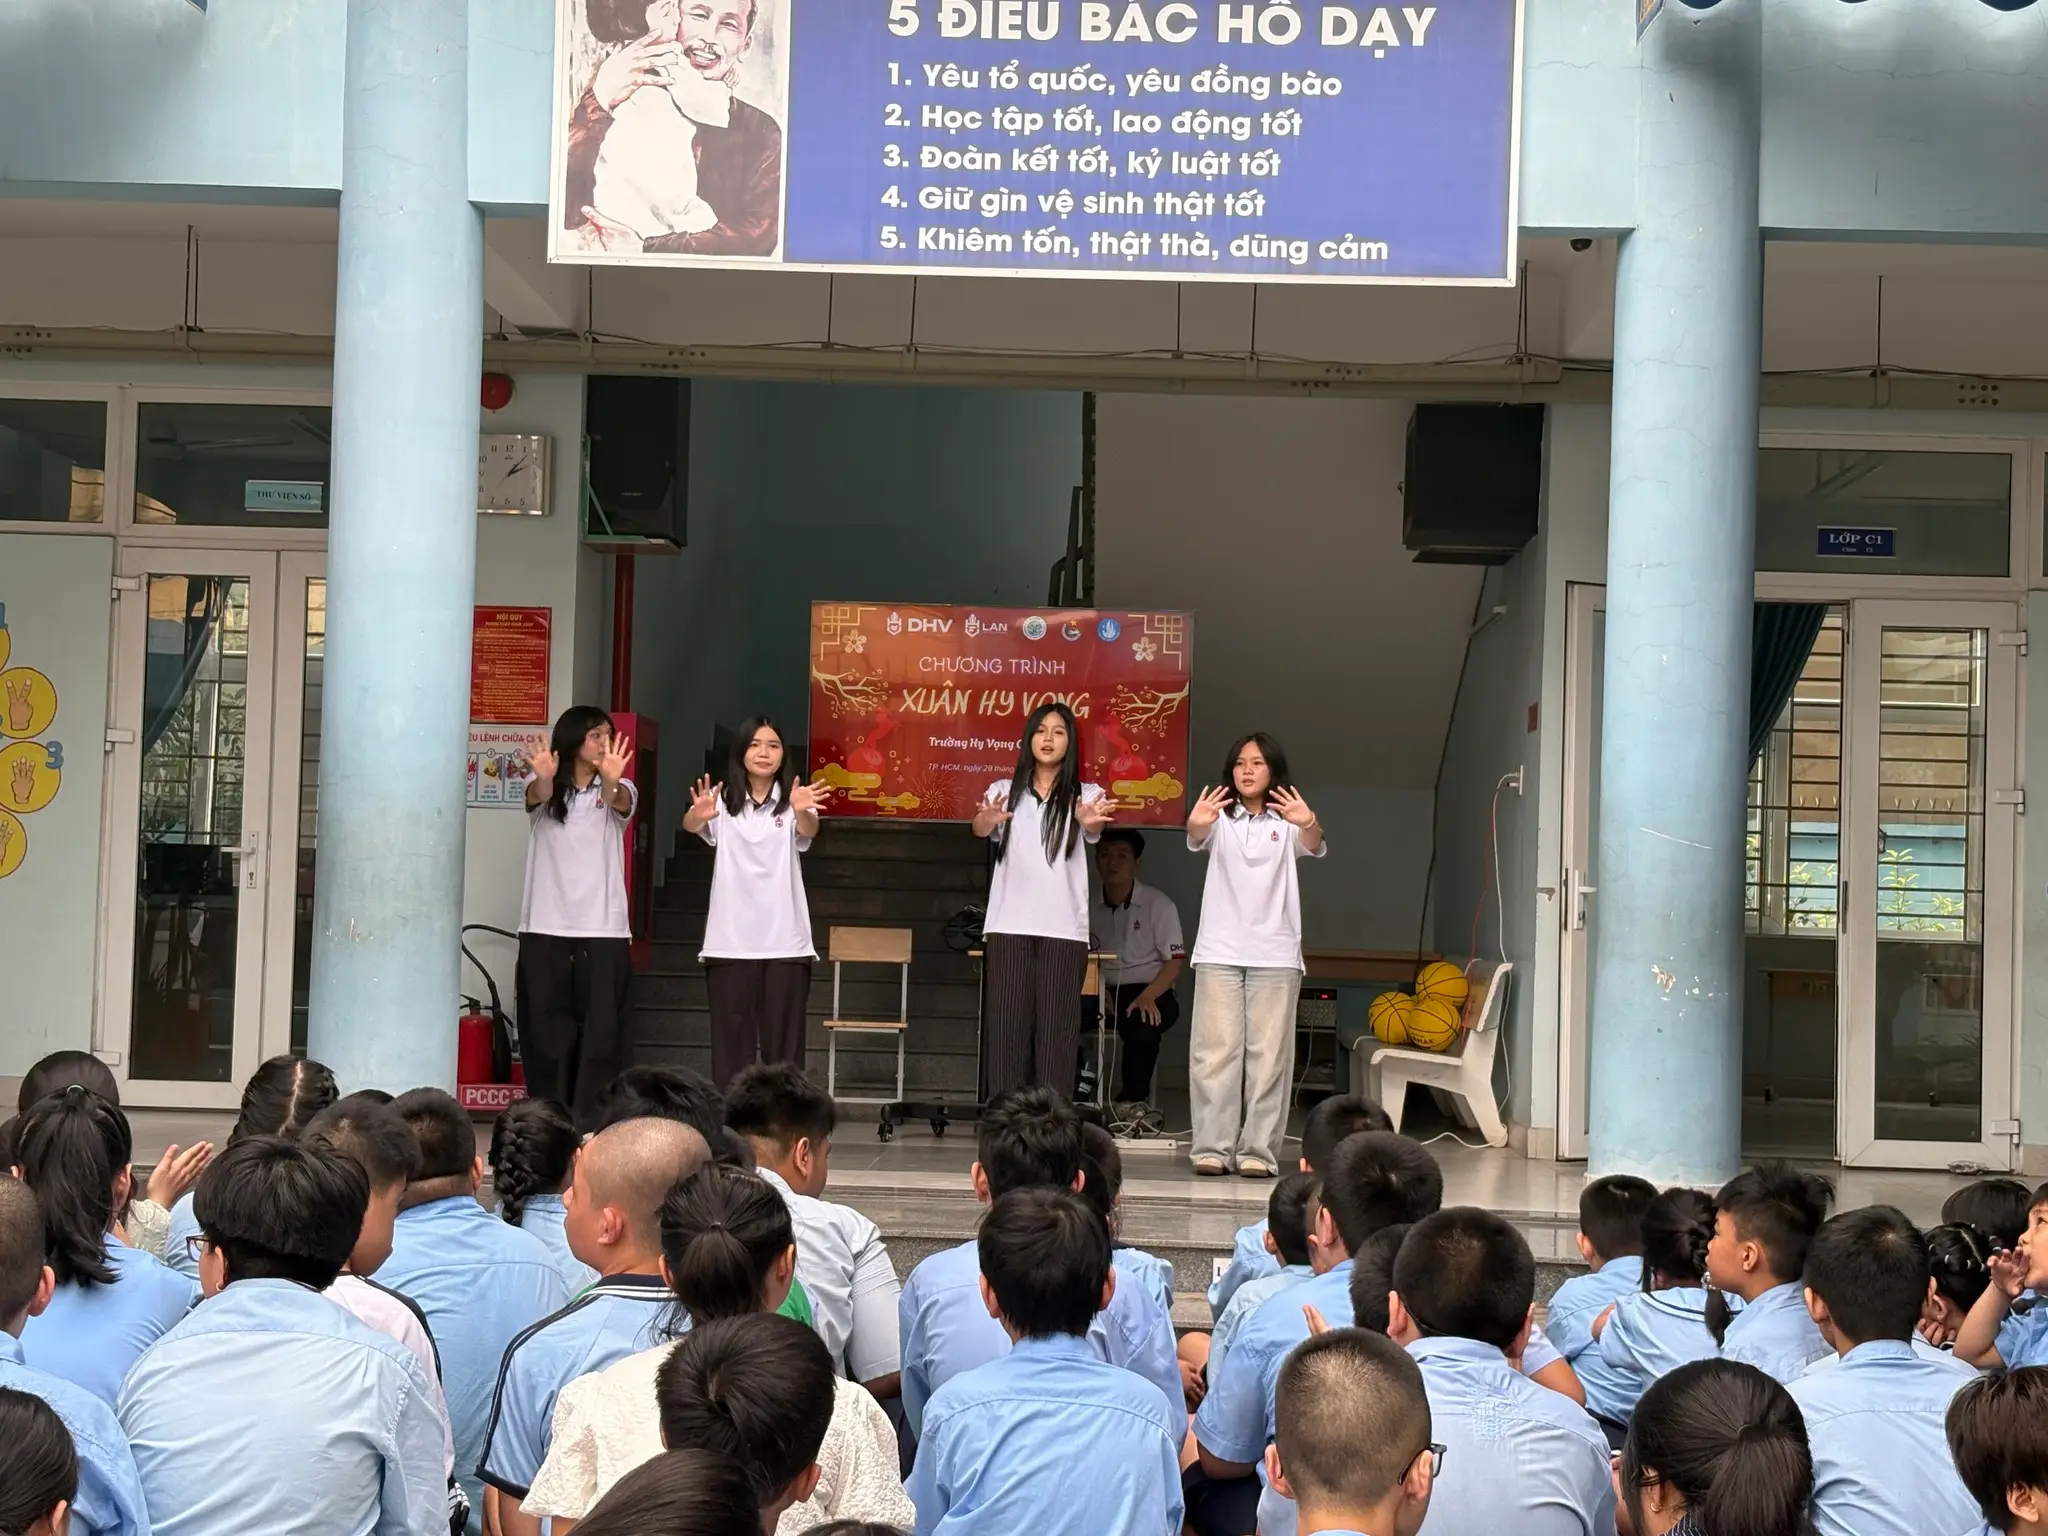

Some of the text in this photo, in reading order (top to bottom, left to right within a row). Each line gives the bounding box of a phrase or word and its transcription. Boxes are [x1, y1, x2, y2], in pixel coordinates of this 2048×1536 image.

[888, 0, 919, 37] 5
[1321, 7, 1437, 58] DẠY
[888, 59, 1342, 101] 1. Yêu tổ quốc, yêu đồng bào
[884, 103, 1303, 141] 2. Học tập tốt, lao động tốt
[883, 144, 1281, 181] 3. Đoàn kết tốt, kỷ luật tốt
[880, 185, 1266, 222] 4. Giữ gìn vệ sinh thật tốt
[880, 225, 1389, 265] 5. Khiêm tốn, thật thà, dũng cảm
[1828, 532, 1882, 545] LỚP C1
[908, 618, 953, 633] DHV
[982, 623, 1008, 632] LAN
[919, 655, 1065, 675] CHƯƠNG TRÌNH
[899, 680, 973, 716] XUÂN
[978, 689, 1014, 716] HY
[480, 732, 500, 743] LỆNH
[929, 736, 968, 750] Trường
[969, 738, 984, 750] Hy
[986, 738, 1014, 751] Vọng
[45, 740, 64, 769] 3
[466, 1088, 510, 1105] PCCC
